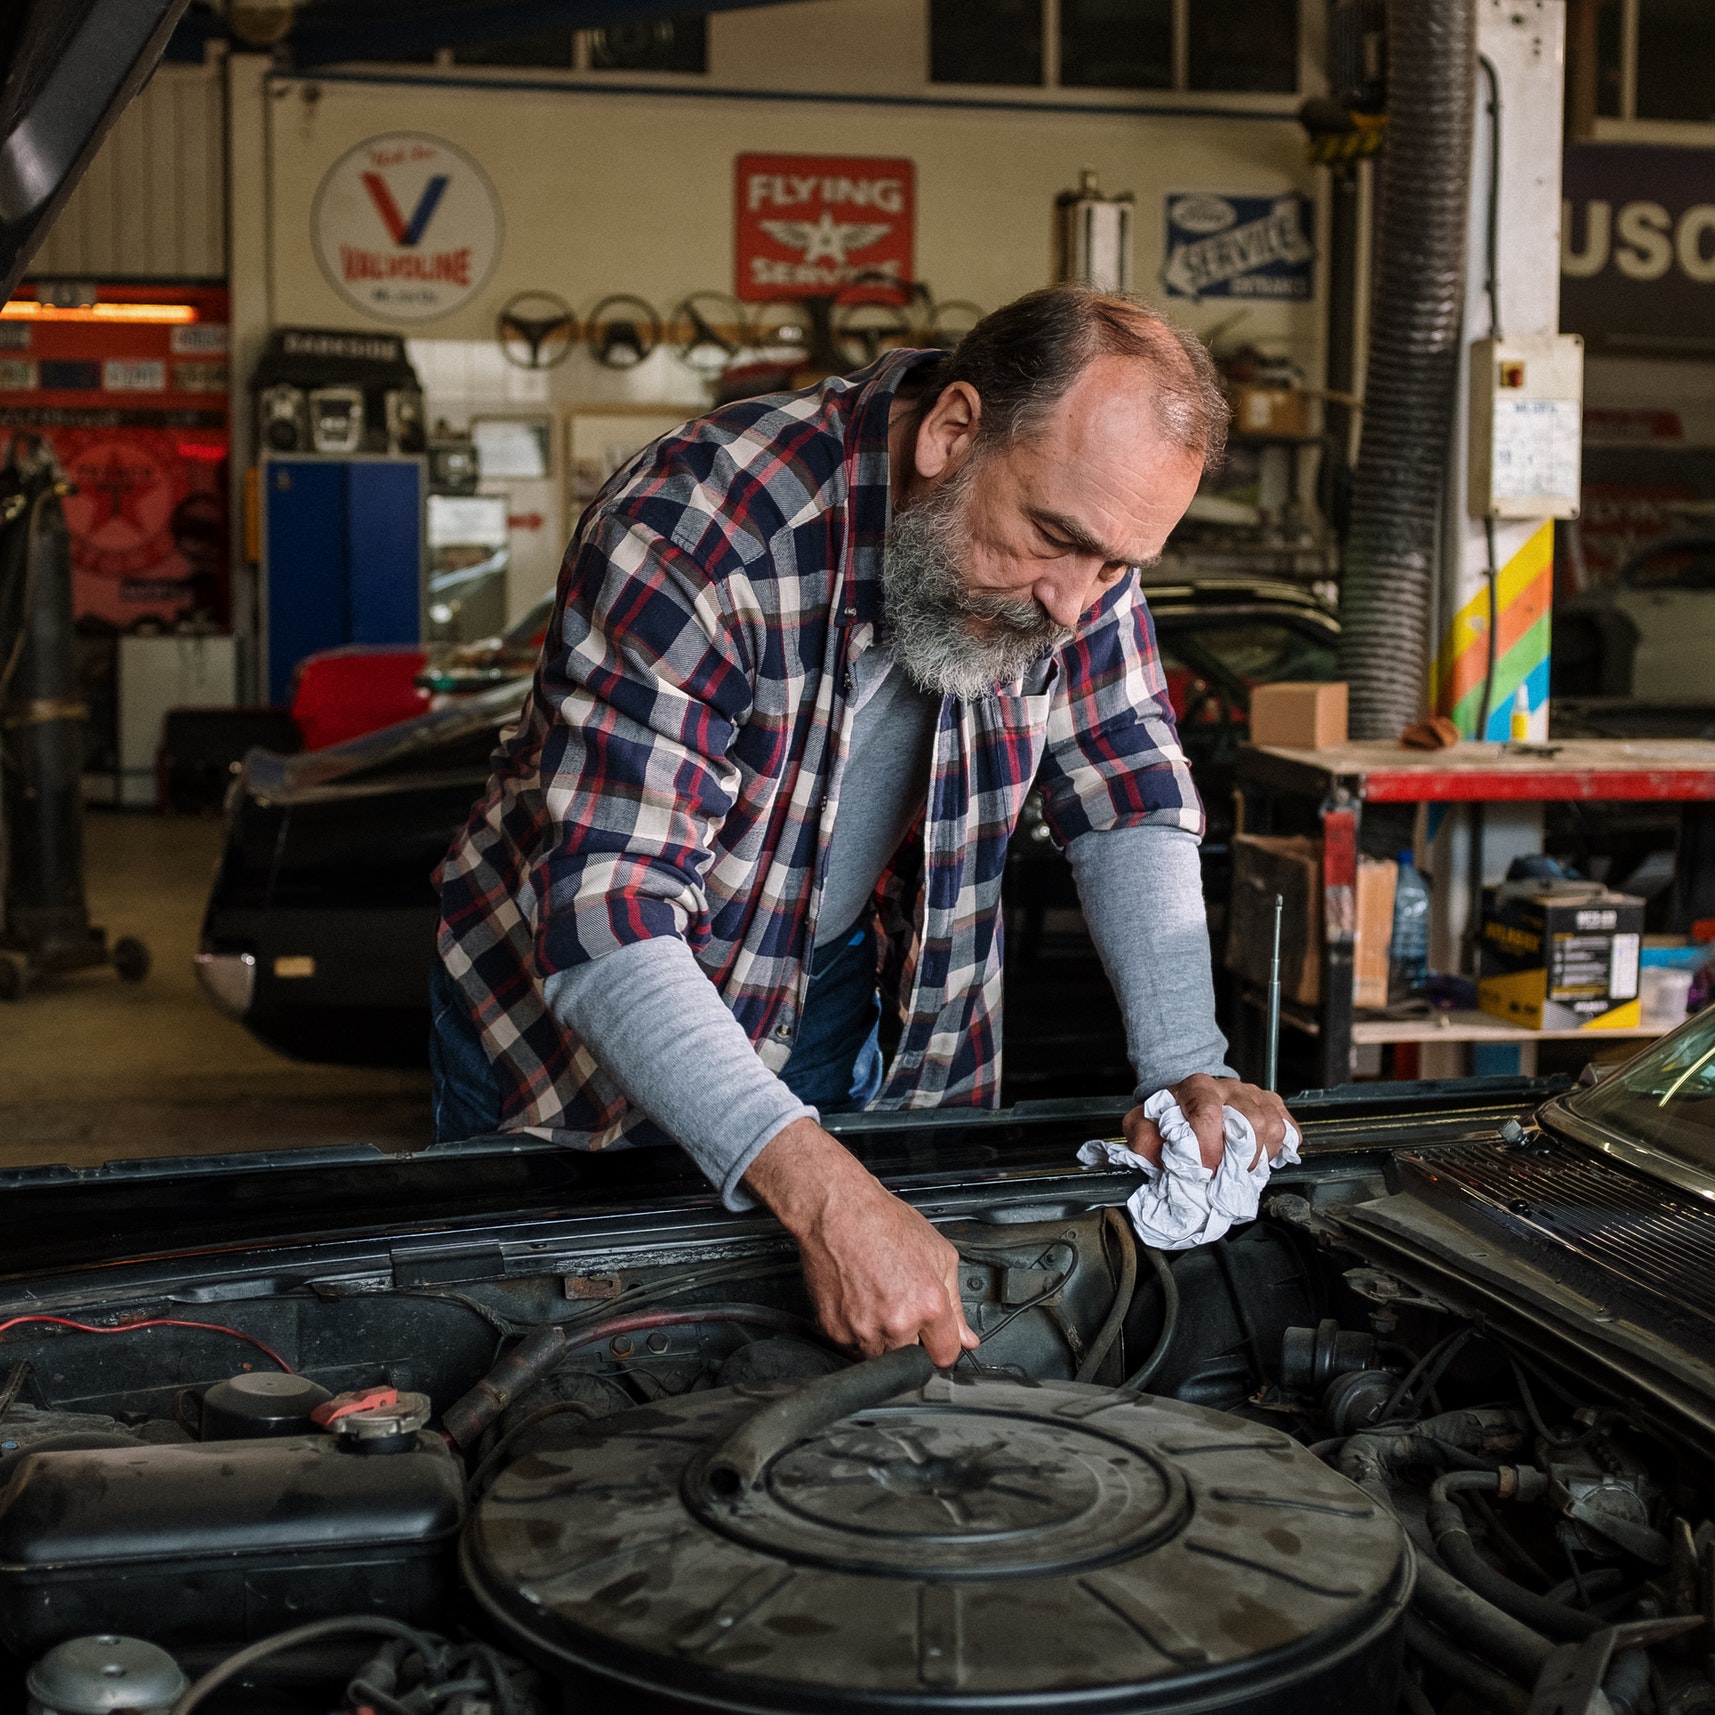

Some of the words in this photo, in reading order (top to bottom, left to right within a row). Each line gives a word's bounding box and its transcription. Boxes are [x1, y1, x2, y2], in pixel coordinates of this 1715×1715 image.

[748, 174, 904, 214] FLYING
[339, 242, 471, 288] VALVOLINE
[1182, 213, 1293, 285] SERVICE
